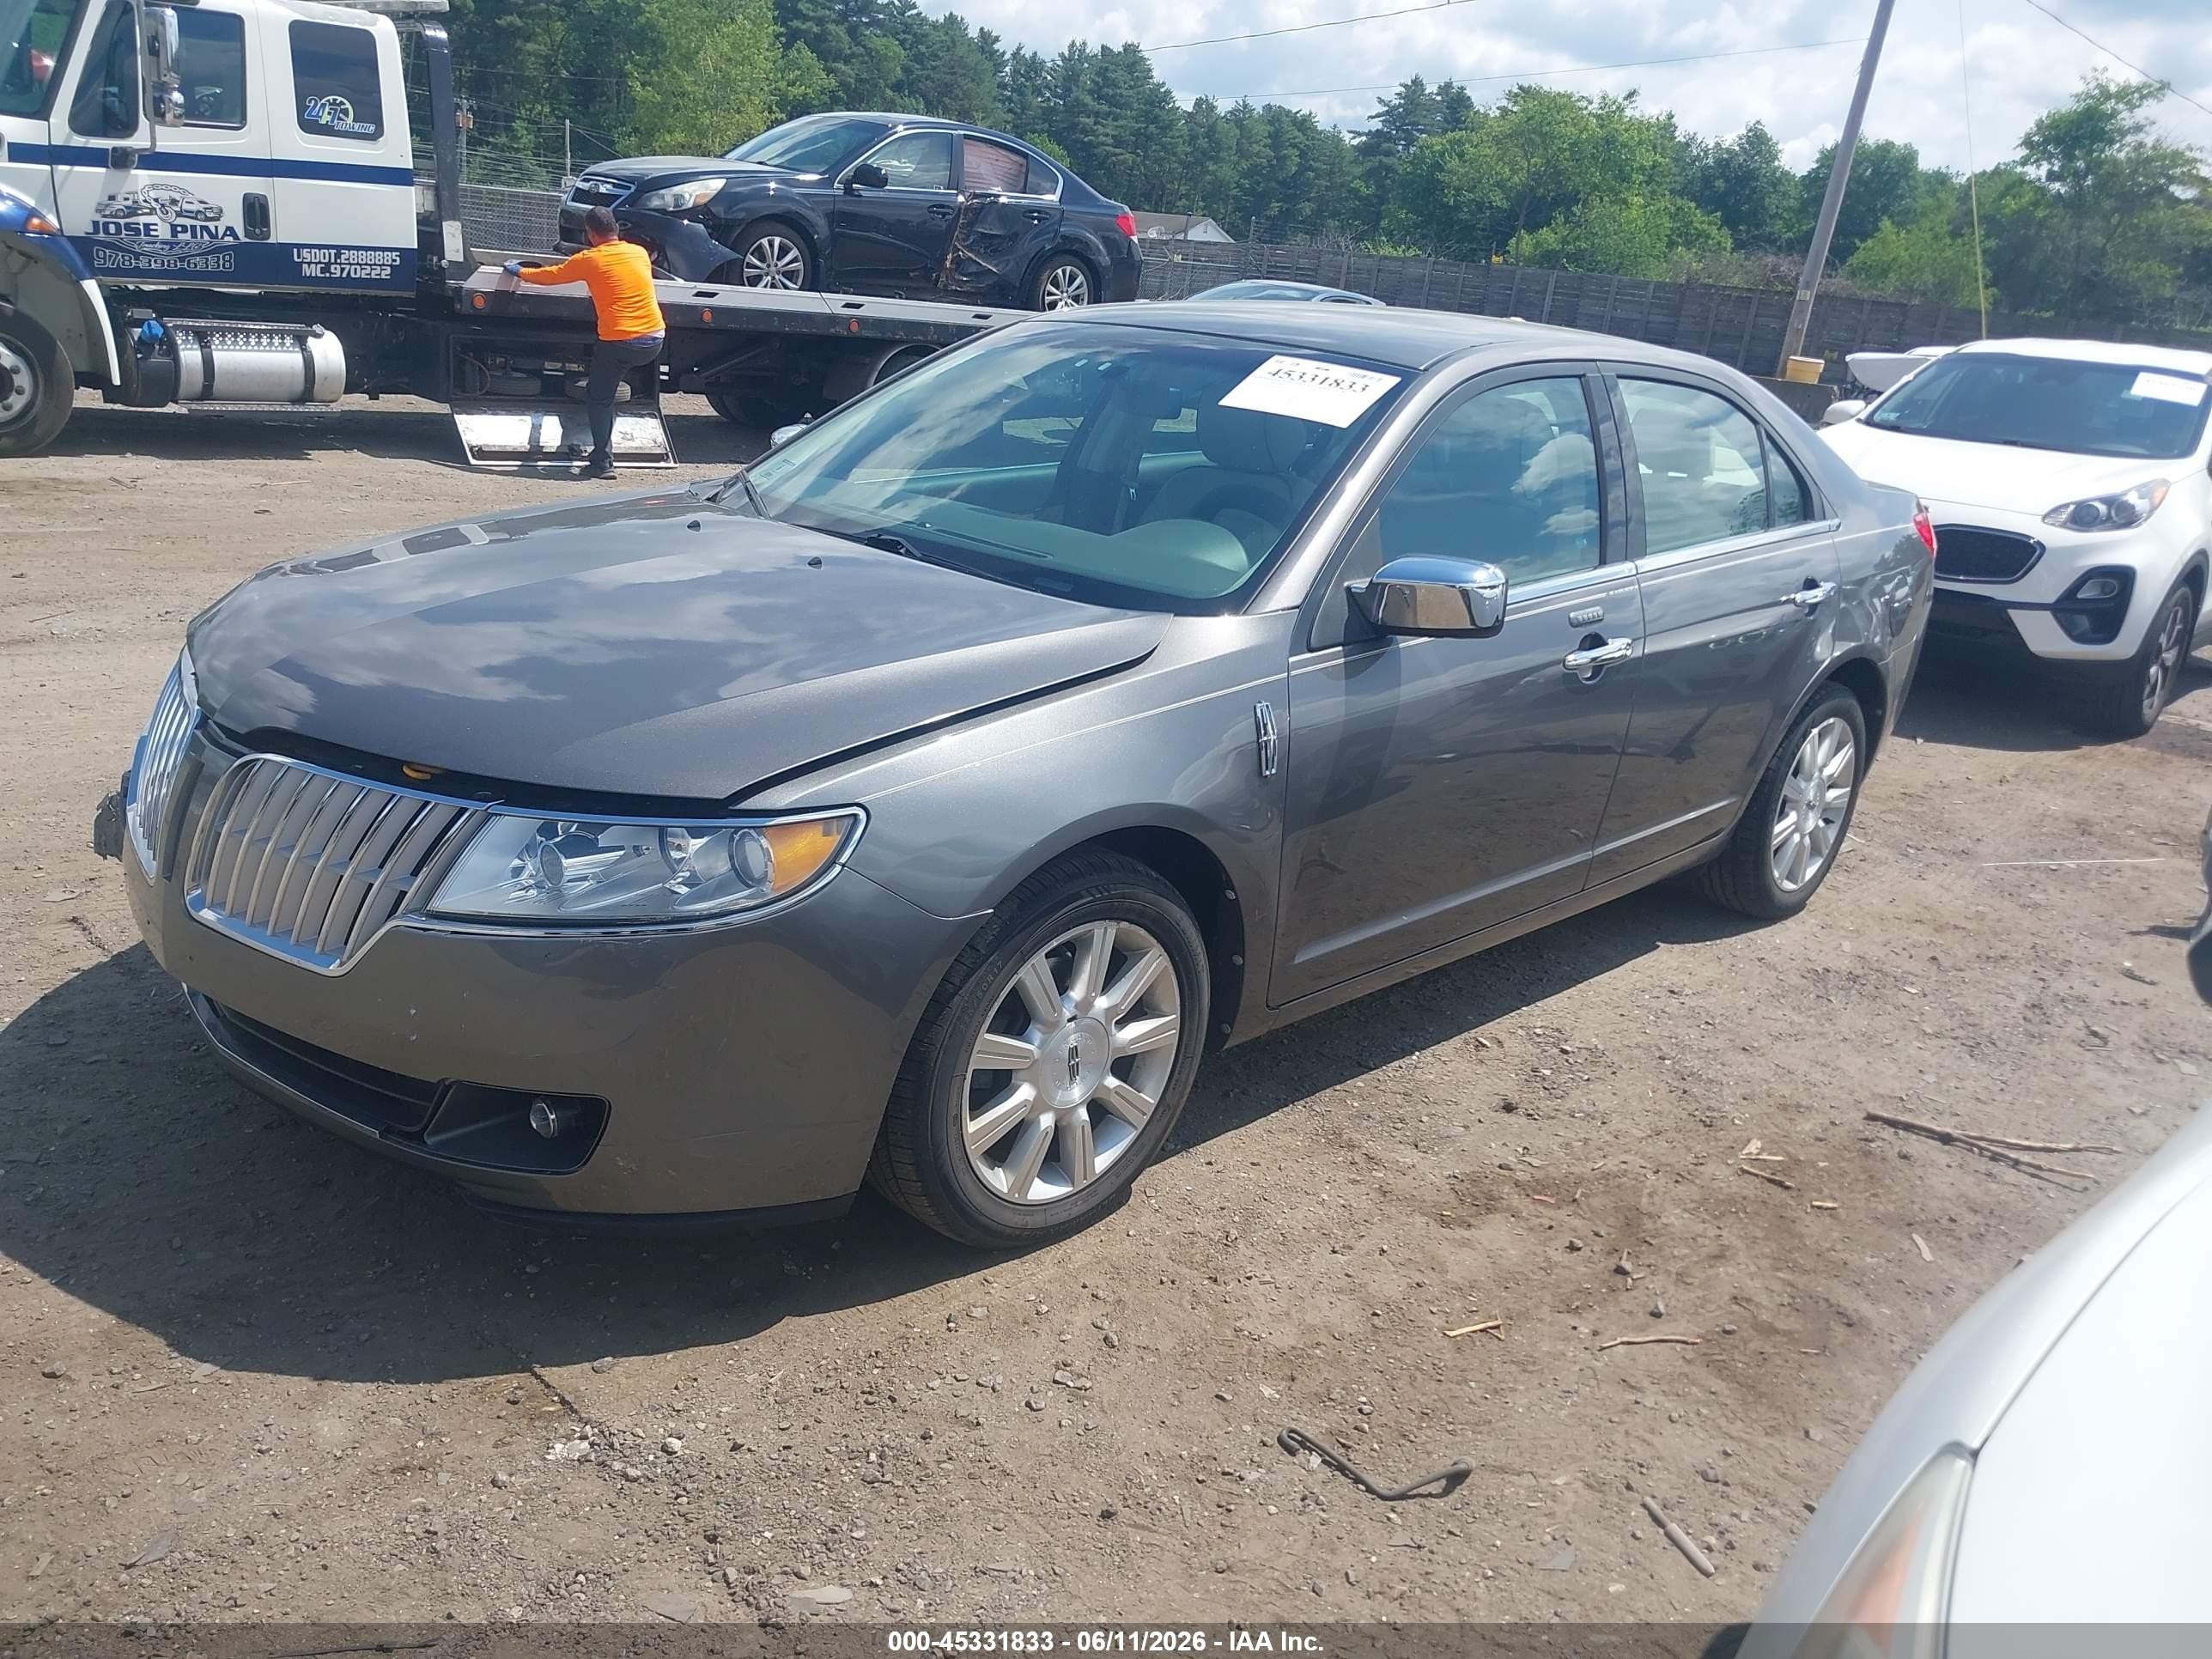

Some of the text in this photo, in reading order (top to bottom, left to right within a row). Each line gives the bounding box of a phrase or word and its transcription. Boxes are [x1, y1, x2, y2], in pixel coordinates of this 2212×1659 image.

[334, 121, 376, 133] TOWING
[85, 220, 241, 240] JOSE PINA
[94, 246, 234, 271] 978-398-6338
[293, 248, 401, 265] USDOT.2888885
[302, 264, 392, 279] MC.970222
[1267, 368, 1370, 392] 45331833
